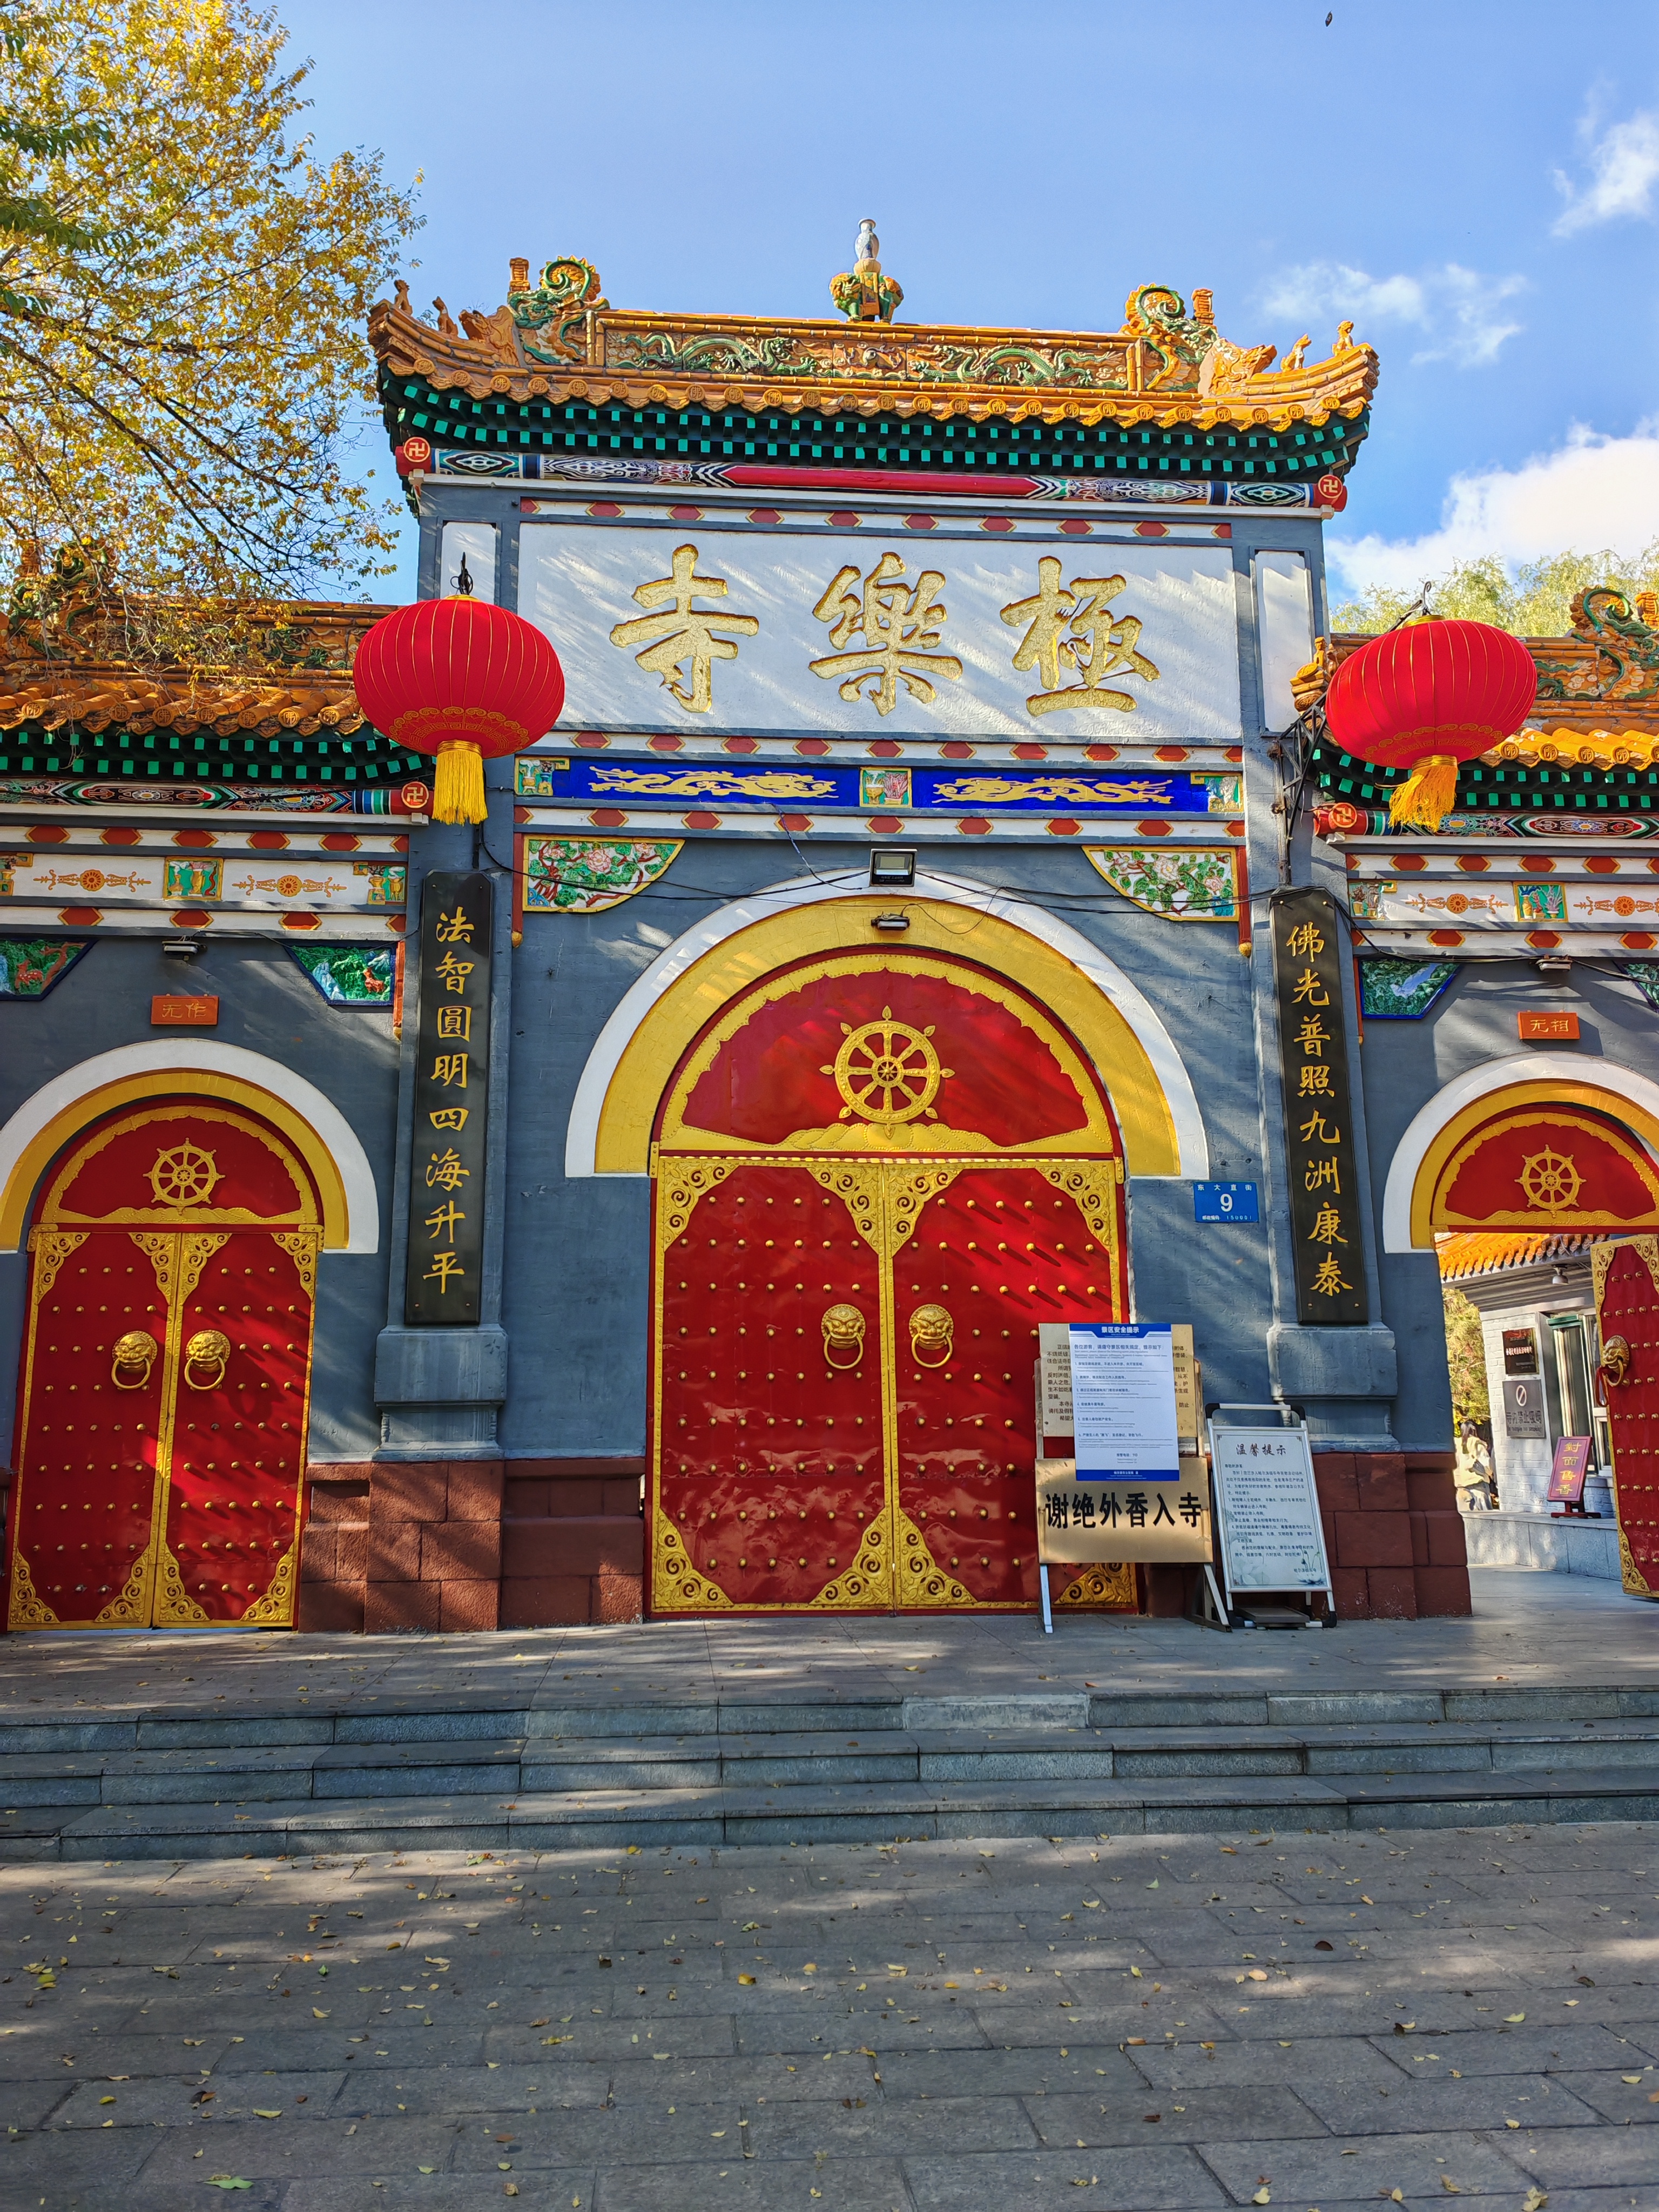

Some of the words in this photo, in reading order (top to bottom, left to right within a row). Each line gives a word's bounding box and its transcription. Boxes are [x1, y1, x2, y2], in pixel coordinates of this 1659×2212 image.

[1529, 1019, 1569, 1033] 无相
[422, 906, 475, 1294] 法智圓明四海升平
[1286, 920, 1354, 1296] 佛光普照九洲康泰
[1220, 1193, 1233, 1212] 9
[1506, 1410, 1541, 1424] 寺内禁止吸烟
[1236, 1442, 1286, 1458] 温馨提示
[1045, 1492, 1202, 1529] 谢绝外香入寺
